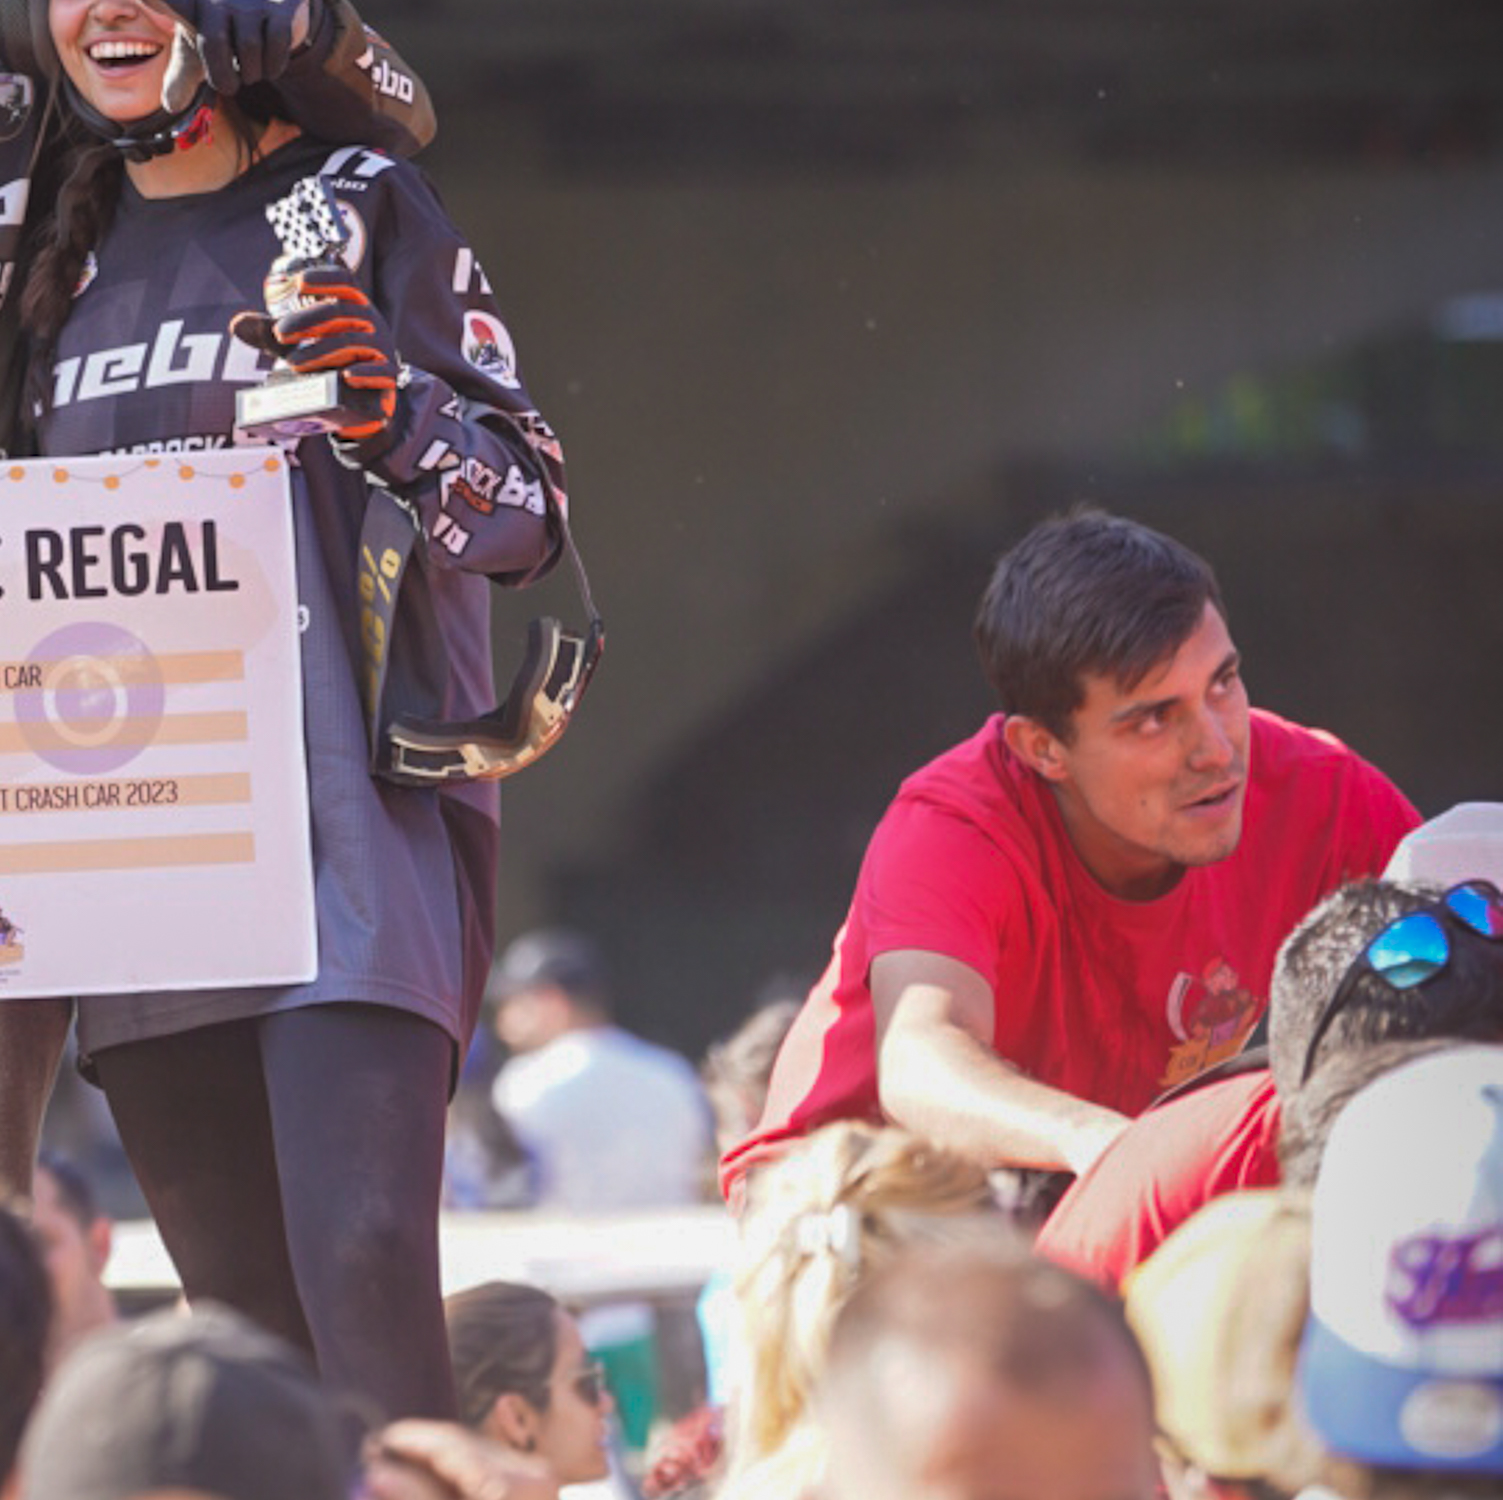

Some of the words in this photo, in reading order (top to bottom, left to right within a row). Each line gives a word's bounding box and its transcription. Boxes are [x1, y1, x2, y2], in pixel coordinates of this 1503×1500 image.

[25, 519, 239, 601] REGAL
[4, 665, 43, 689] CAR
[15, 785, 79, 811] CRASH
[83, 783, 121, 807] CAR
[126, 780, 179, 806] 2023
